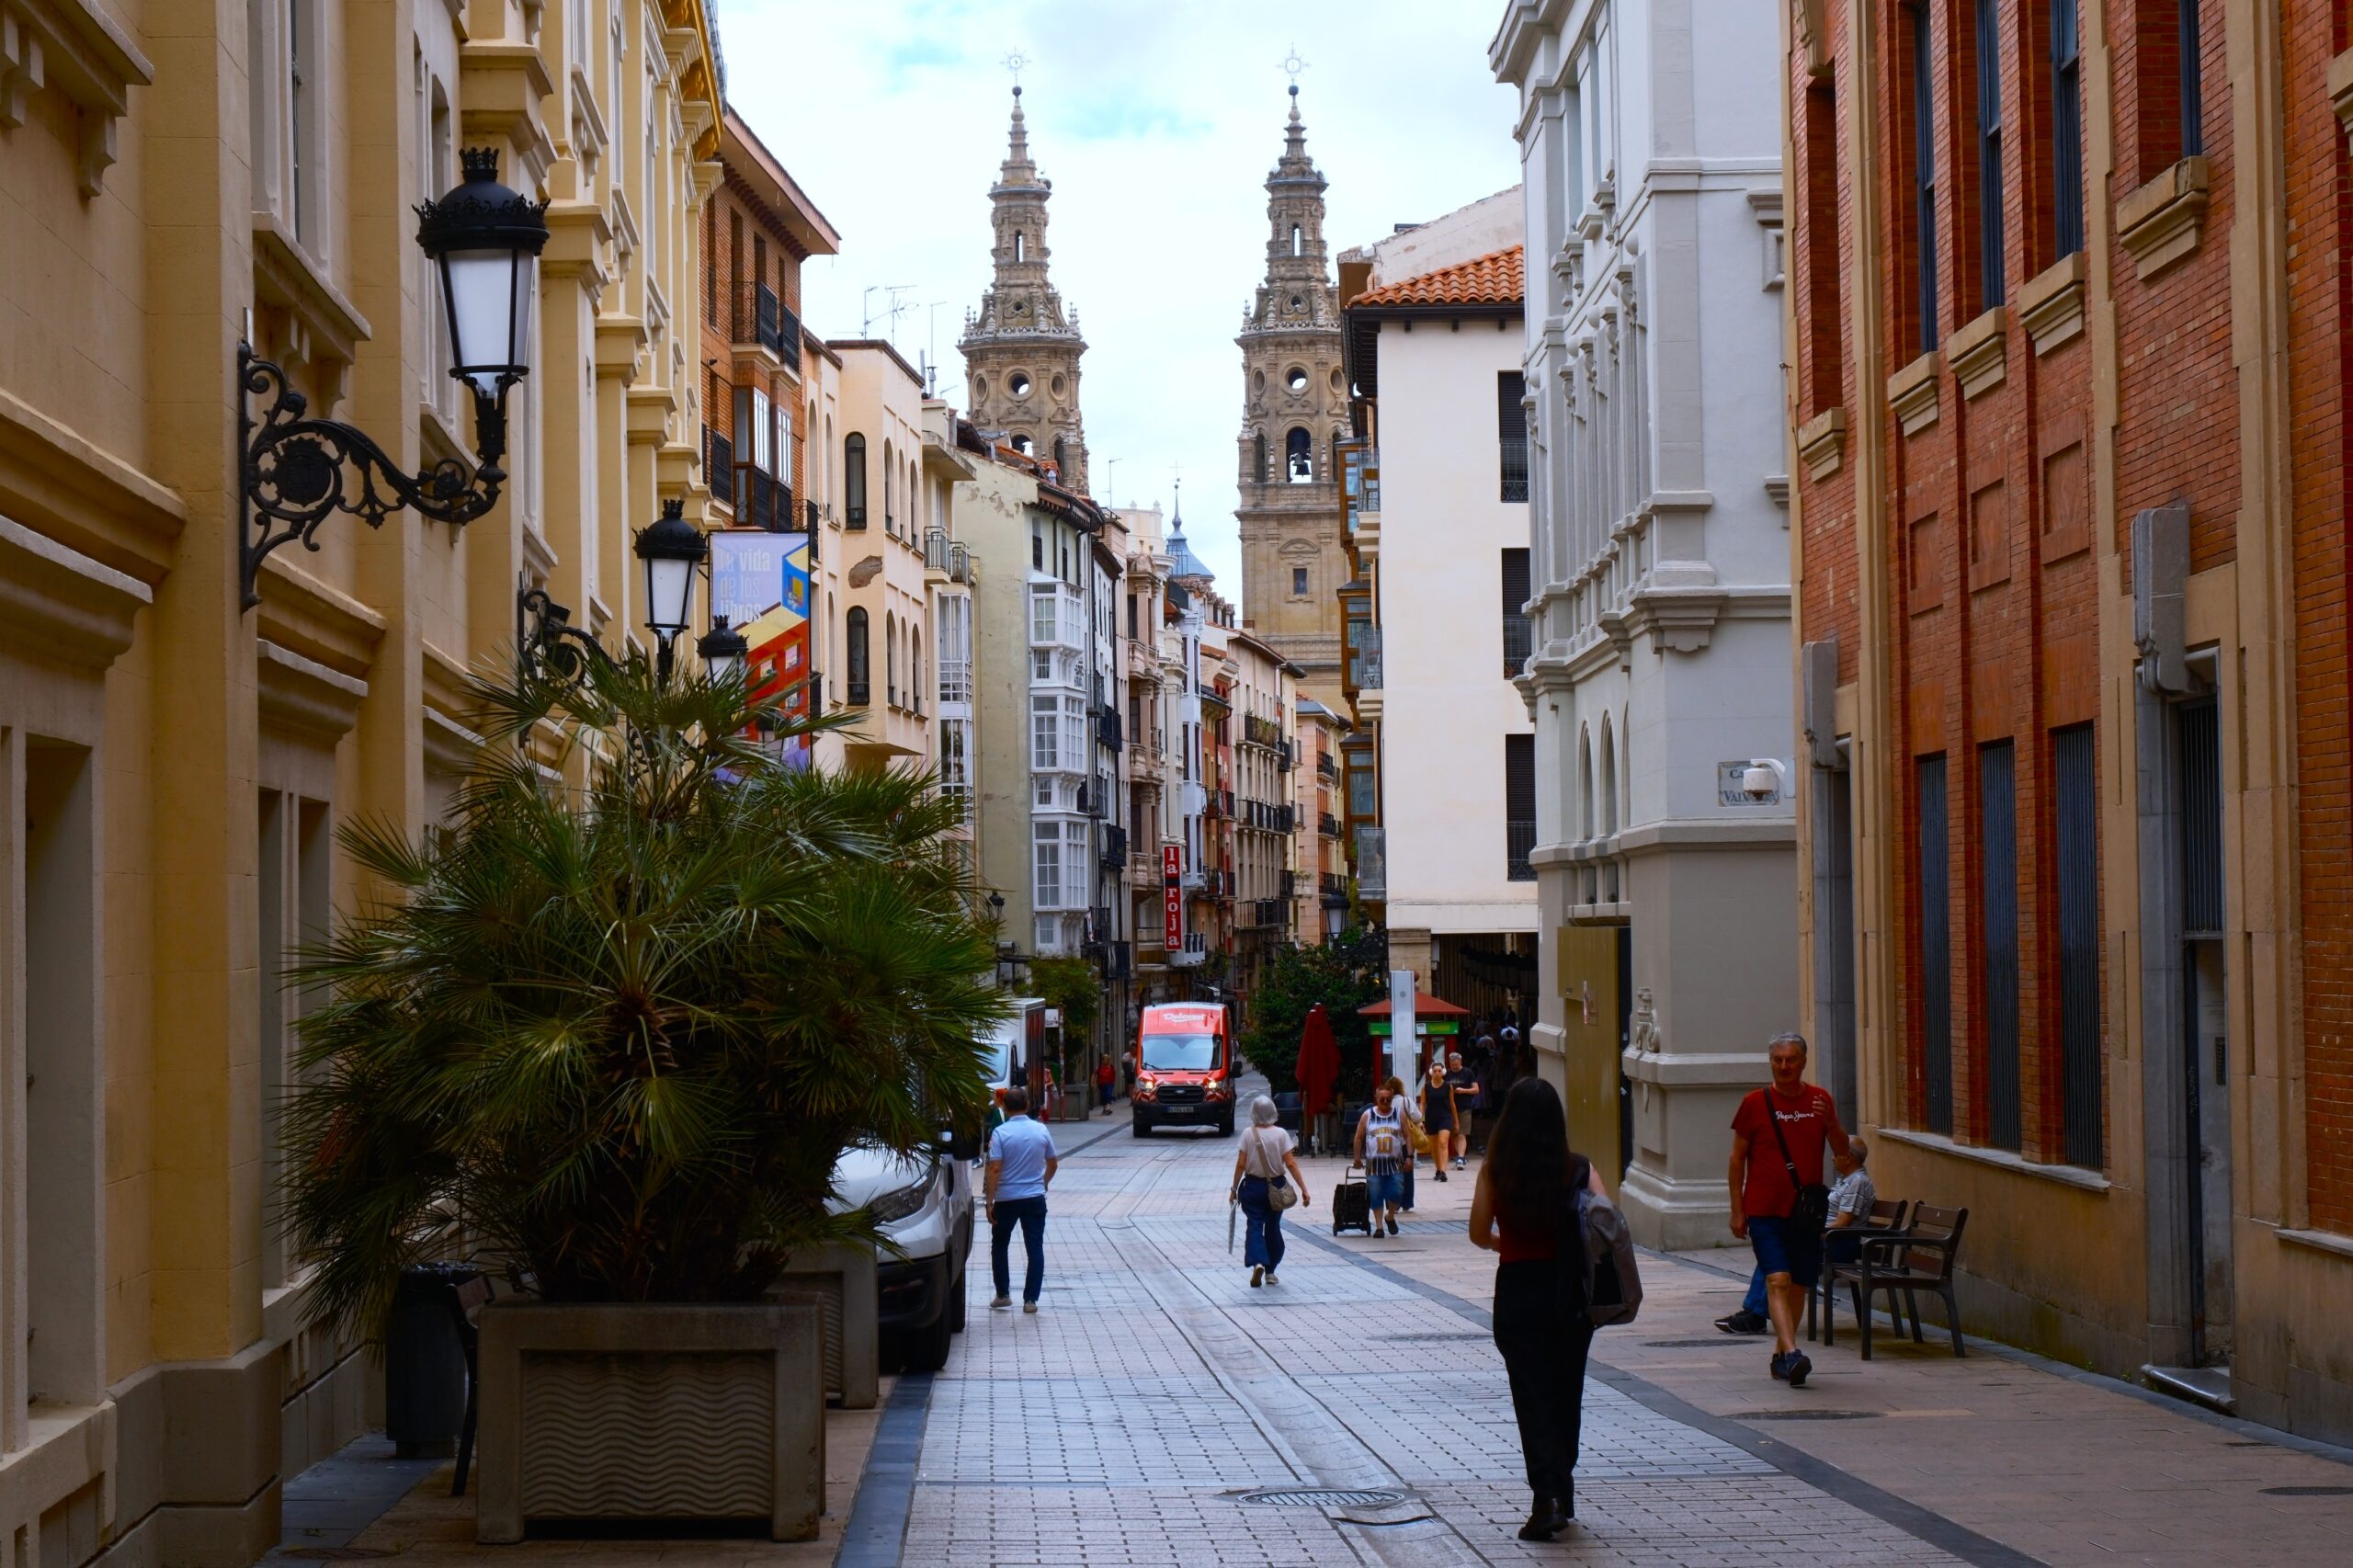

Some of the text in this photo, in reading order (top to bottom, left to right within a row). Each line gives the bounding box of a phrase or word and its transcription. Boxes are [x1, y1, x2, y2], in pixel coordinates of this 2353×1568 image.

[739, 548, 771, 572] vida
[721, 574, 759, 597] de los
[720, 599, 762, 625] libros
[1166, 847, 1180, 946] la roja
[1377, 1136, 1392, 1154] 10
